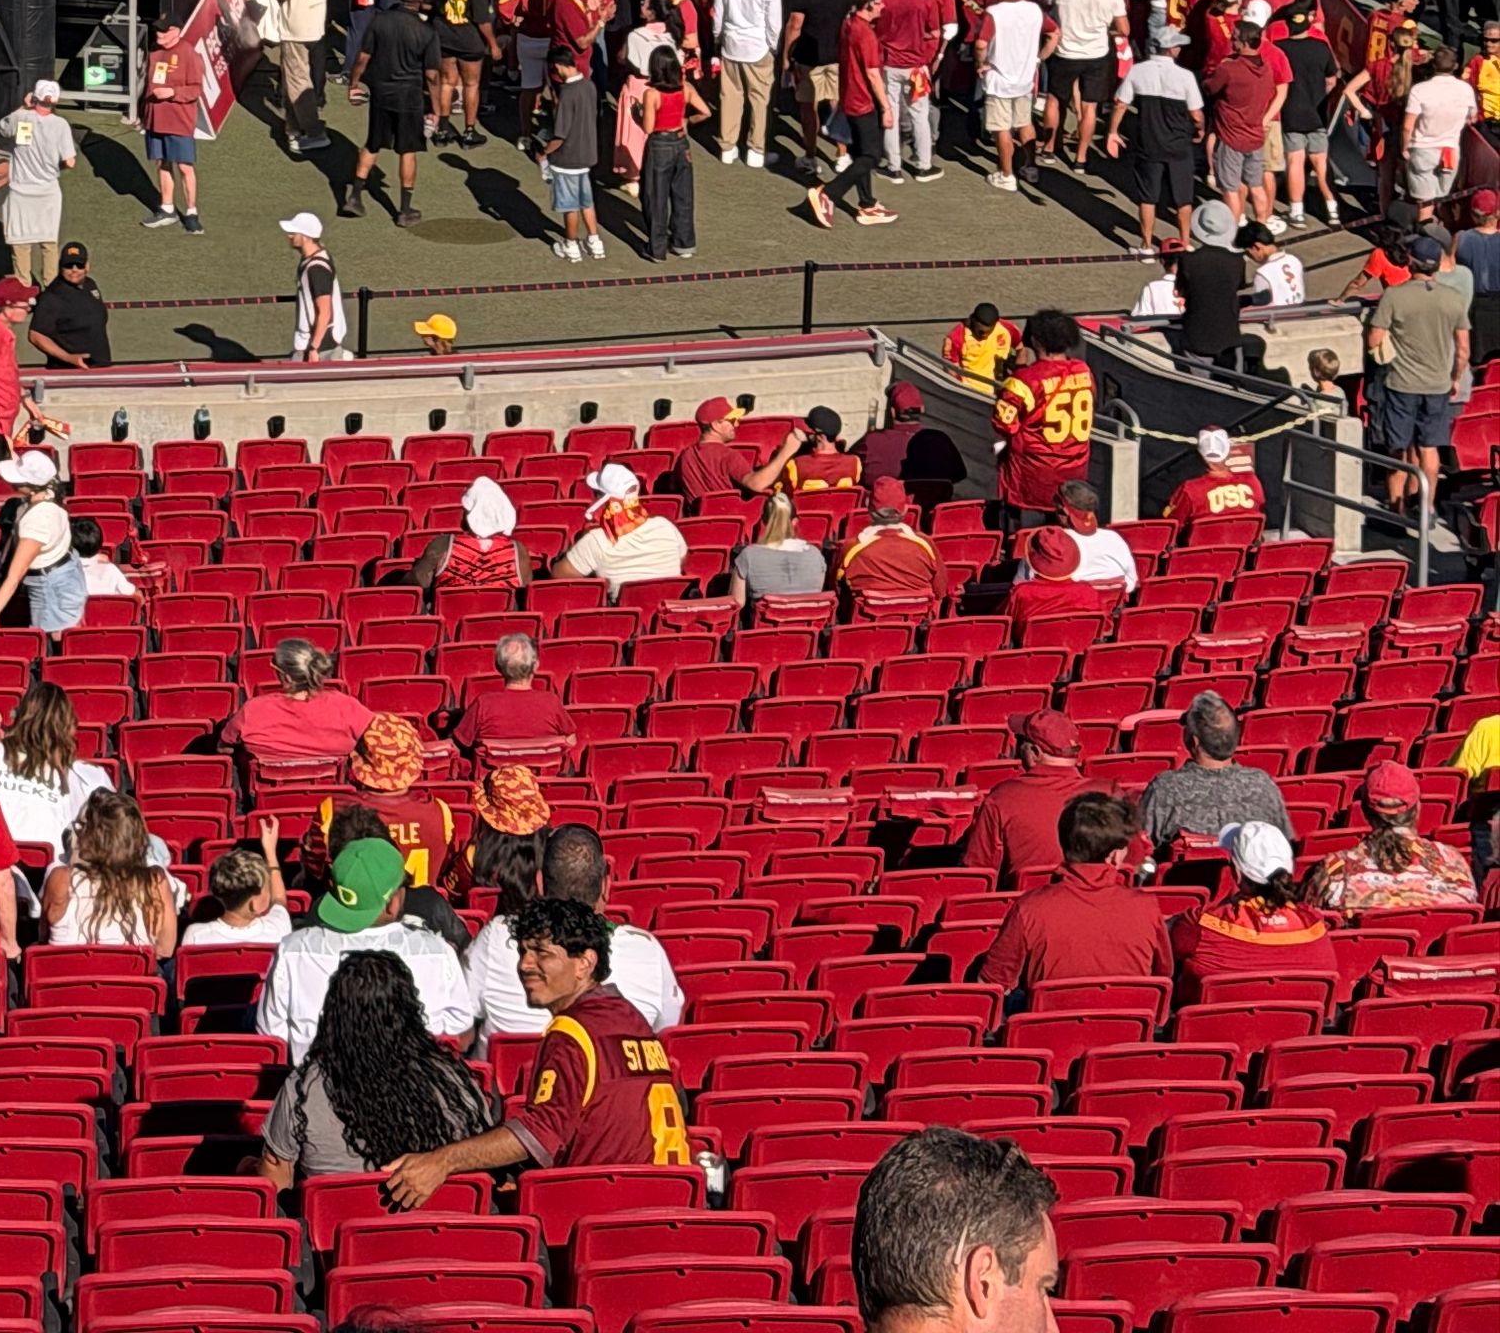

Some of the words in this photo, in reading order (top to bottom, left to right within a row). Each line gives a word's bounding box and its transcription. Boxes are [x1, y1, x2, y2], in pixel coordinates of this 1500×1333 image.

[1043, 390, 1093, 442] 58
[1207, 483, 1256, 514] USC
[533, 1068, 558, 1106] 8
[648, 1083, 691, 1166] 8
